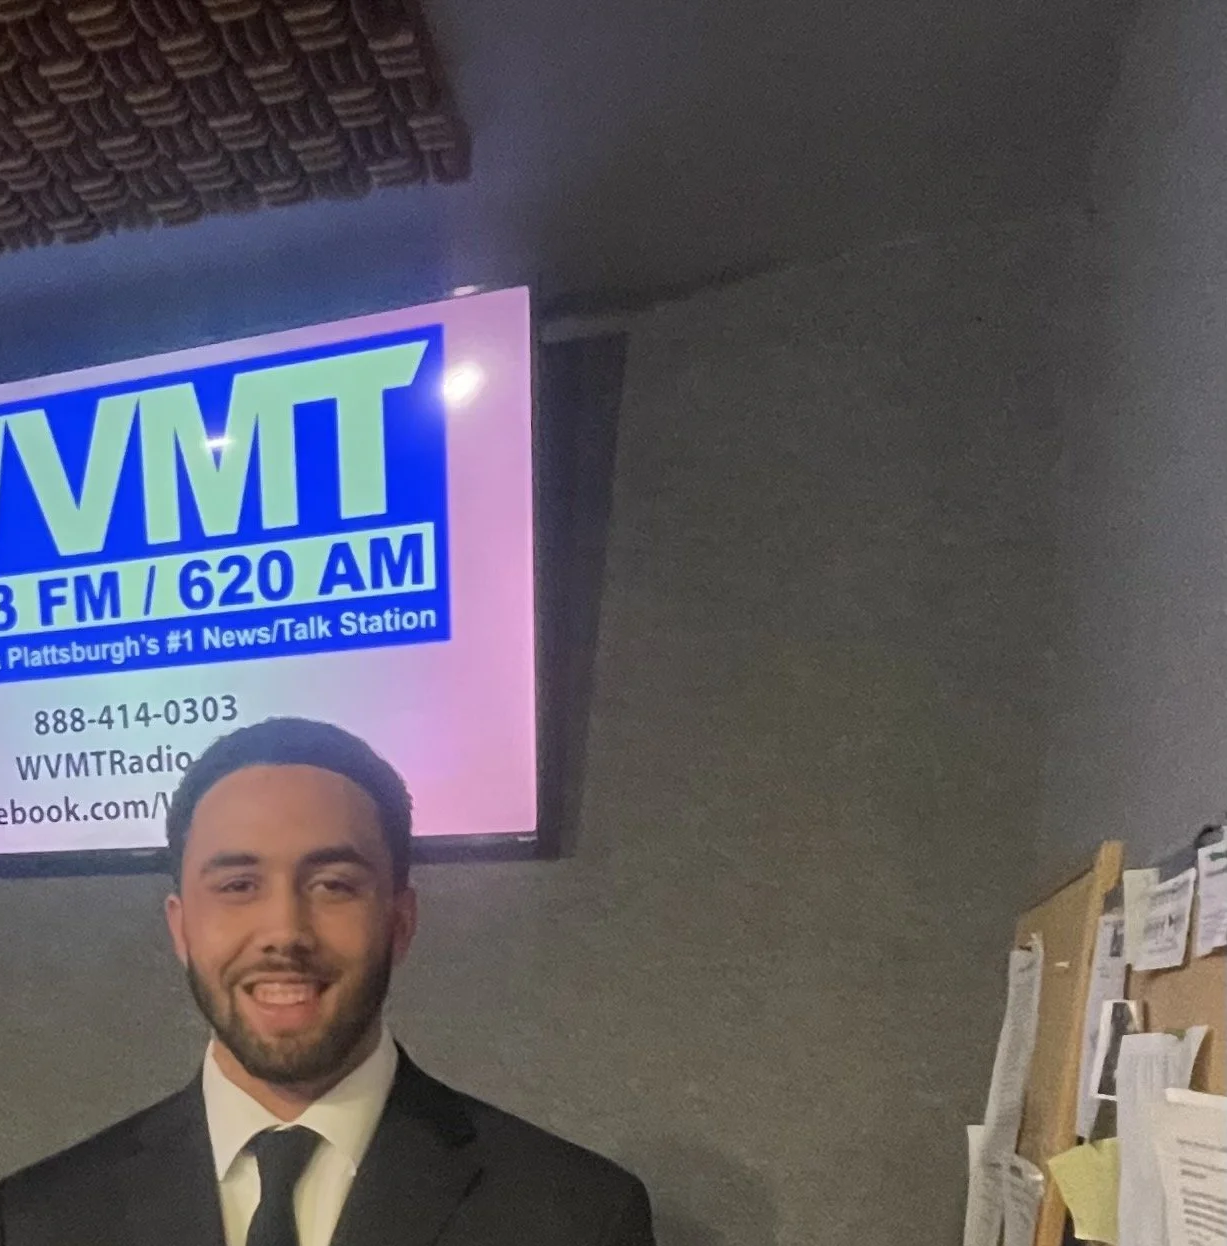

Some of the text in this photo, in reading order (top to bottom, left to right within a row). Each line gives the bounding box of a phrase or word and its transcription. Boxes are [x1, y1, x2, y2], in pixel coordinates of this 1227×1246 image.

[38, 571, 121, 626] FM
[143, 565, 156, 616] /
[179, 550, 294, 610] 620
[318, 532, 424, 595] AM
[7, 634, 160, 668] Plattsburgh's
[166, 629, 193, 654] #1
[203, 616, 332, 650] News/Talk
[340, 607, 436, 636] Station
[34, 694, 238, 735] 888-414-0303
[16, 745, 193, 781] WVMTRadio
